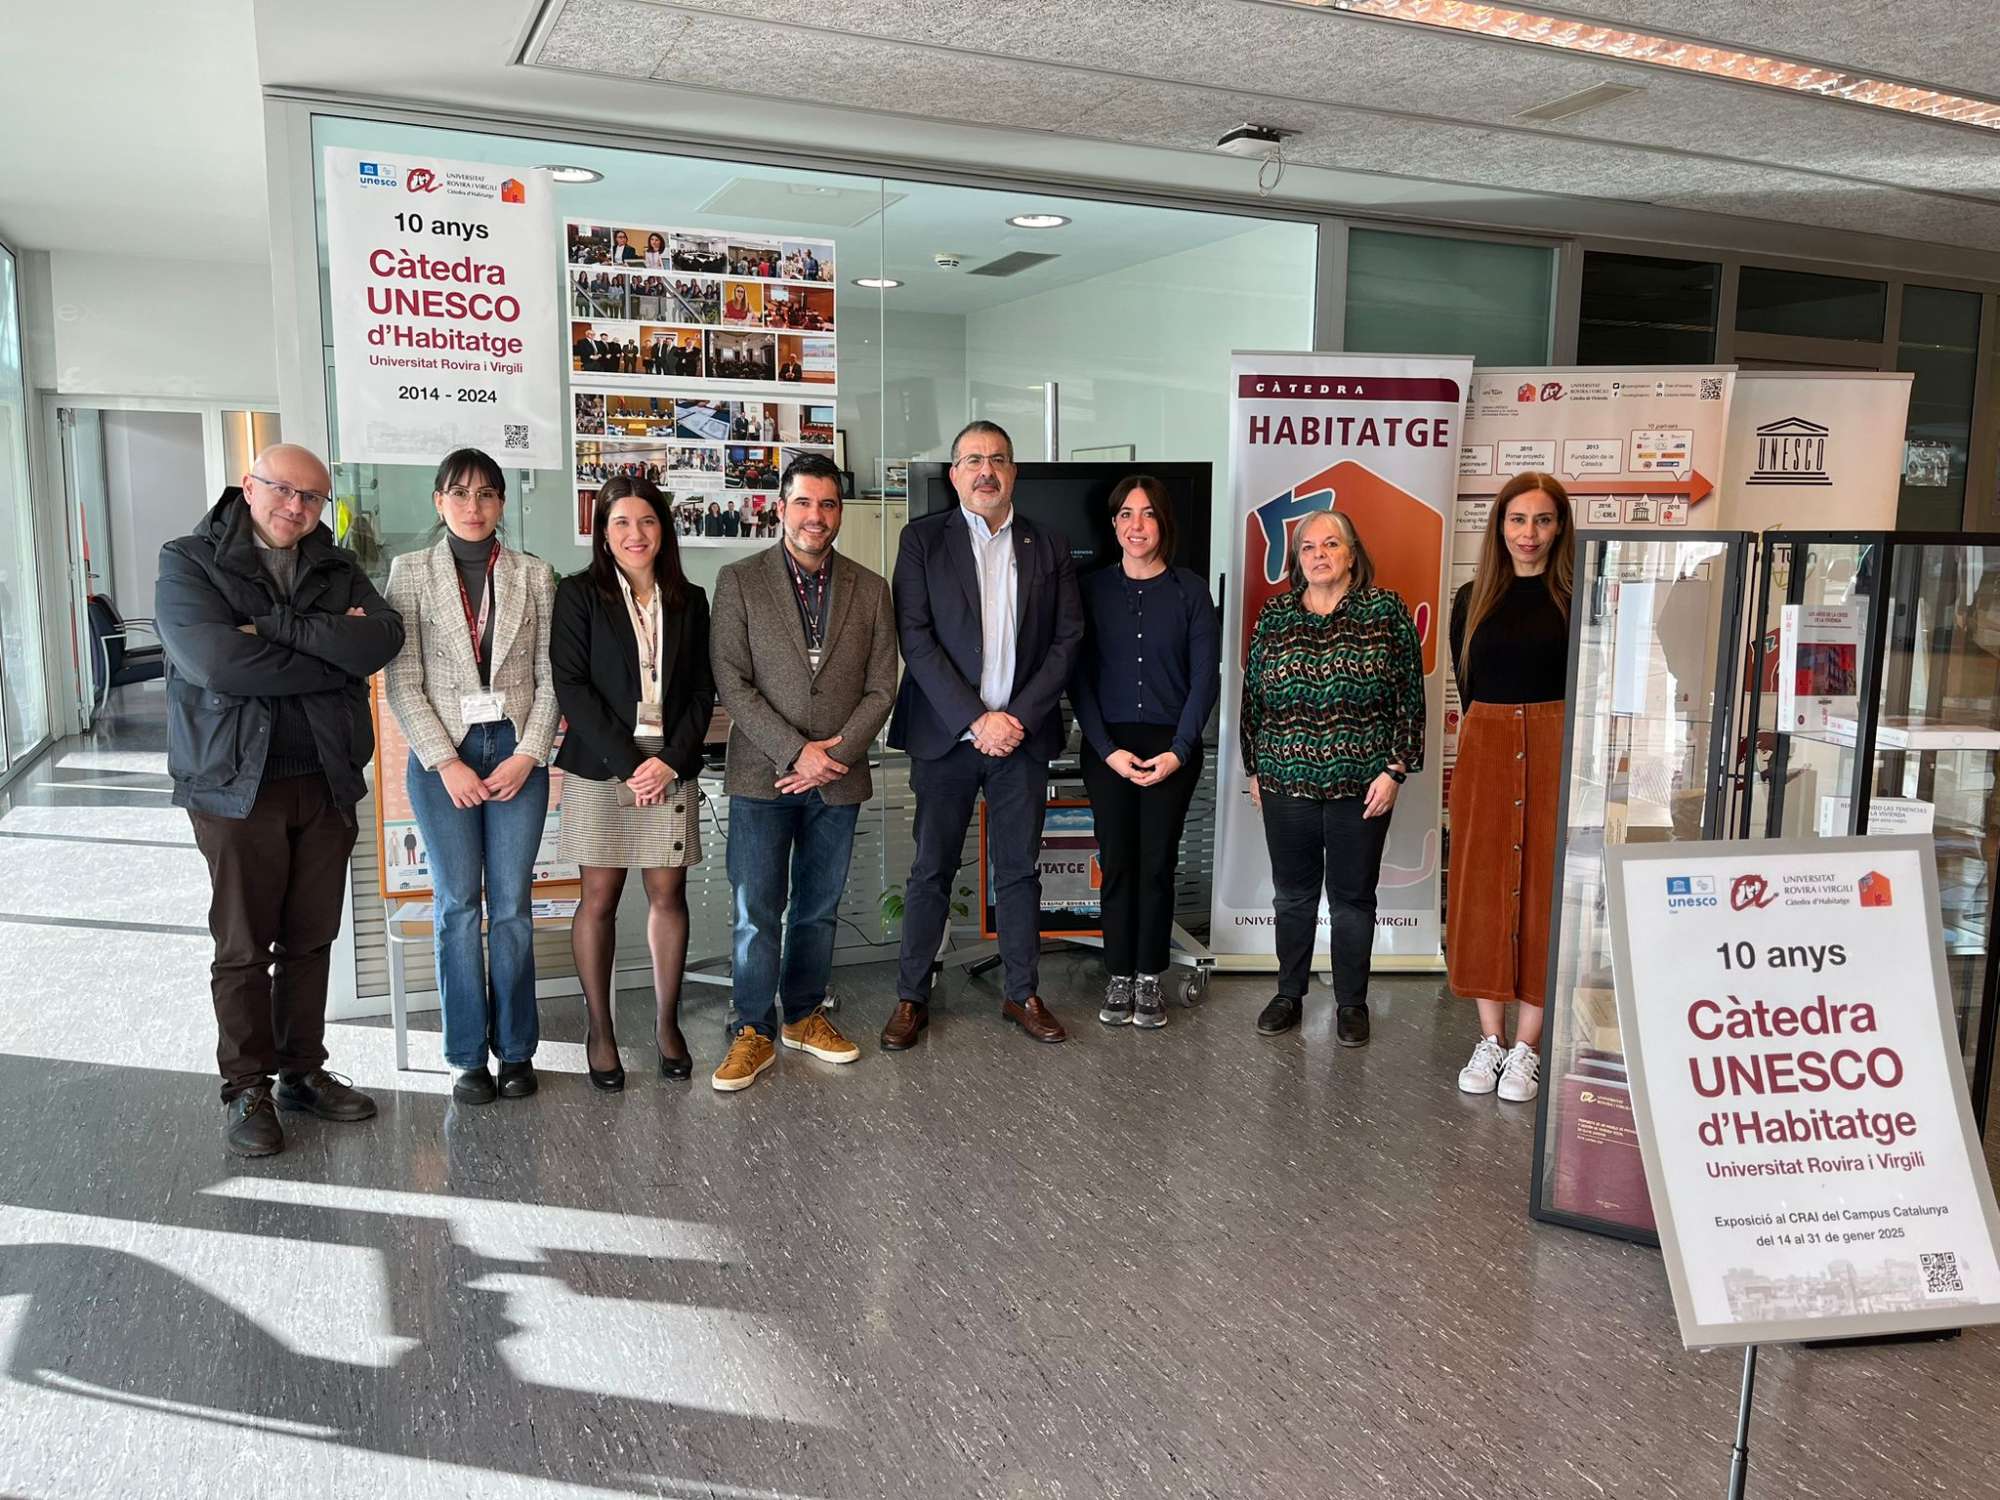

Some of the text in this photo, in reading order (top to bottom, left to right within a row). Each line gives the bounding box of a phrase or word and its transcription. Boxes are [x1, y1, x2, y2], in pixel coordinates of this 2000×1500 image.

[360, 176, 397, 188] unesco
[446, 172, 484, 182] UNIVERSITAT
[394, 212, 490, 241] 10 anys
[369, 248, 506, 286] Càtedra
[367, 286, 520, 322] UNESCO
[369, 355, 523, 374] Universitat Rovira i Virgili
[398, 386, 440, 400] 2014
[458, 388, 498, 404] 2024
[1256, 381, 1364, 394] CÀTEDRA
[1249, 415, 1449, 447] HABITATGE
[1758, 438, 1824, 470] UNESCO
[1783, 874, 1835, 883] UNIVERSITAT
[1784, 886, 1816, 894] ROVIRA
[1822, 884, 1853, 893] VIRGILI
[1668, 897, 1717, 908] unesco
[1716, 941, 1847, 973] 10 anys
[1687, 996, 1877, 1041] Càtedra
[1689, 1047, 1904, 1098] UNESCO
[1706, 1151, 1926, 1179] Universitat Rovira i Virgili
[1715, 1205, 1949, 1228] Exposició al CRAI del Campus Catalunya
[1756, 1227, 1905, 1247] del 14 al 31 de gener 2025
